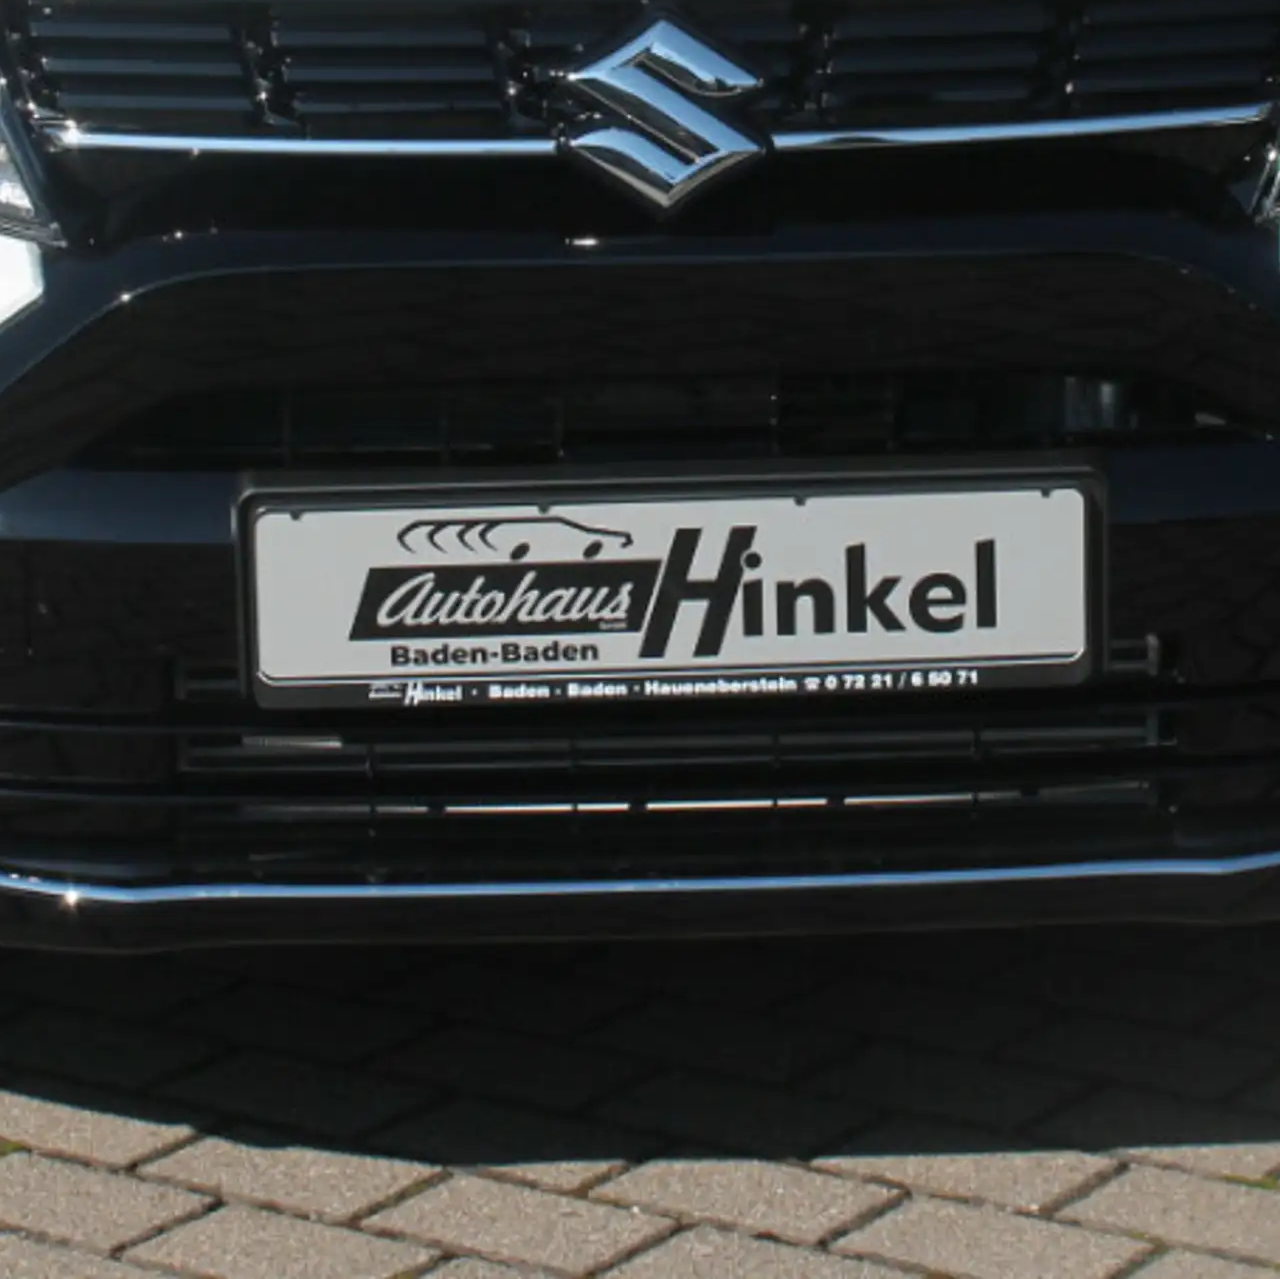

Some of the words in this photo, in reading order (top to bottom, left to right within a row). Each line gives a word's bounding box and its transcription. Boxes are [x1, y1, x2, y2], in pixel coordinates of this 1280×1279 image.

[376, 571, 634, 627] Autohaus
[638, 524, 997, 659] Hinkel
[390, 641, 599, 667] Baden-Baden
[488, 684, 551, 699] Baden
[568, 681, 628, 697] Baden
